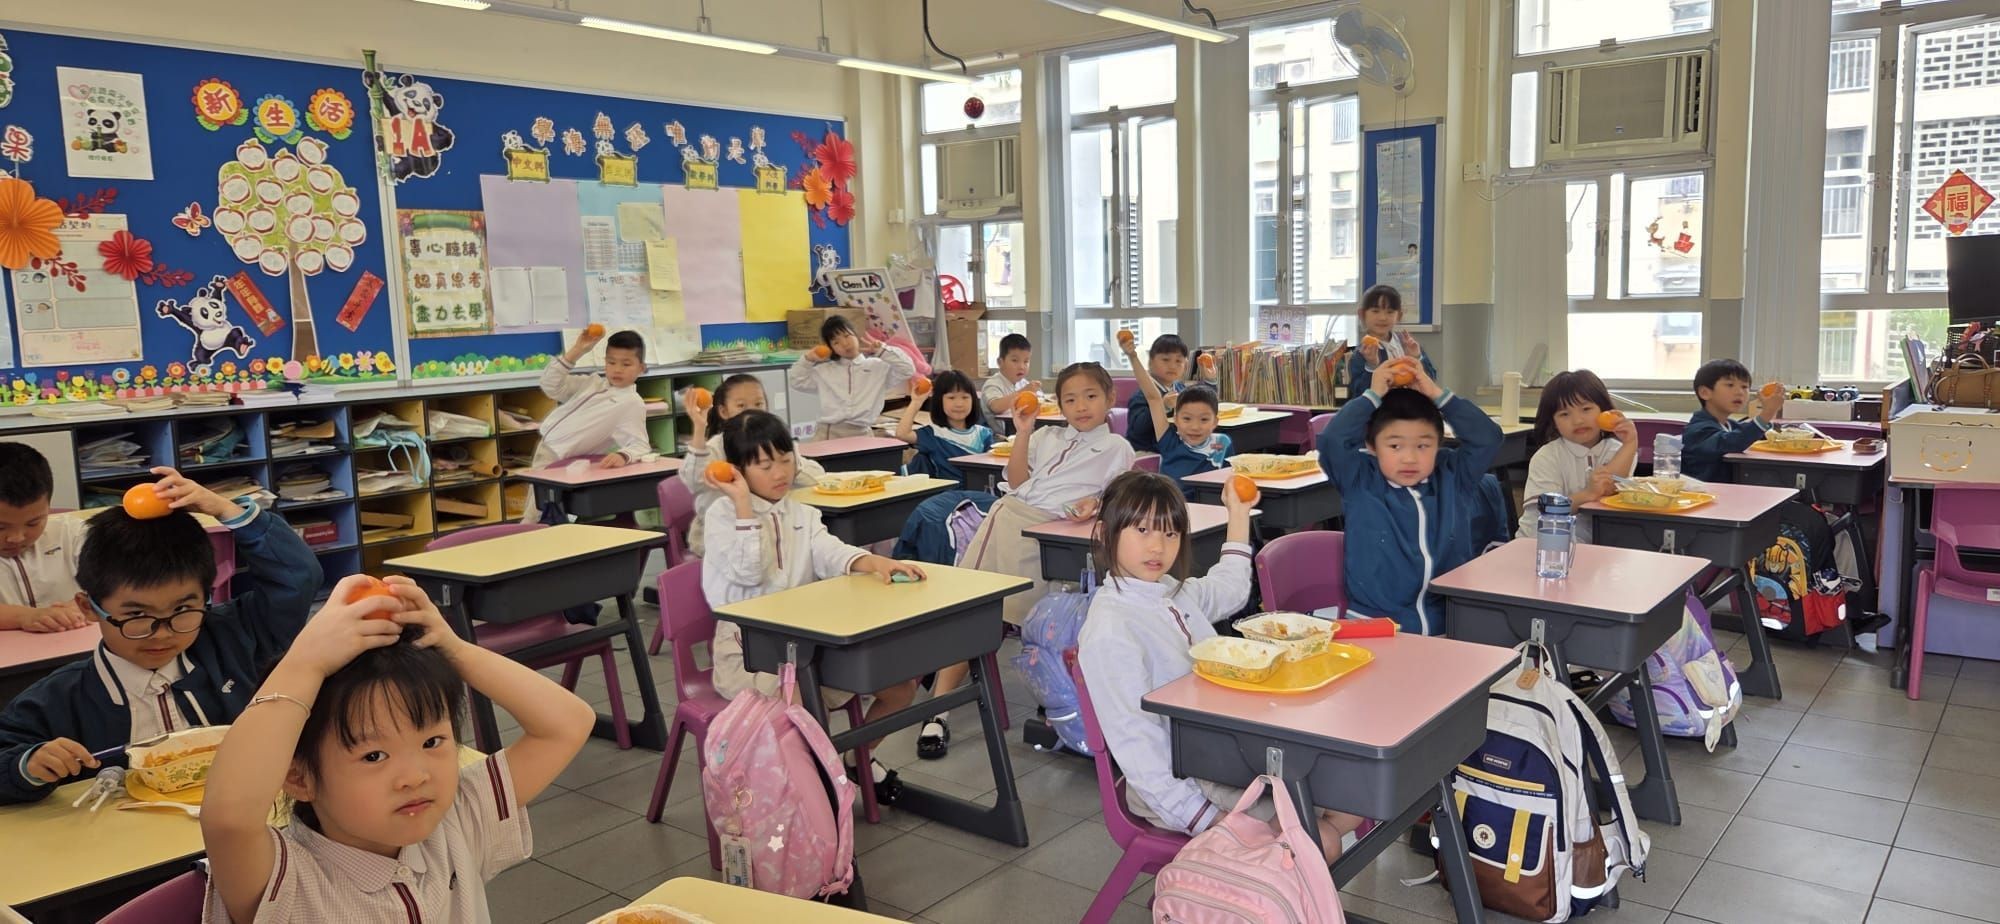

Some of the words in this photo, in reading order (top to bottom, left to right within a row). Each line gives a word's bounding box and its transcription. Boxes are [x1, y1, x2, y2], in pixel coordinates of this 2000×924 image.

[204, 88, 345, 127] 新生活
[3, 127, 30, 160] 果
[391, 117, 433, 156] 1A
[512, 156, 545, 173] 中文科
[1947, 191, 1969, 213] 福
[409, 239, 480, 258] 專心聽講
[21, 274, 30, 284] 2
[413, 271, 482, 290] 認真思考
[862, 275, 880, 288] 1A
[24, 304, 34, 314] 3
[415, 302, 484, 323] 盡力去學
